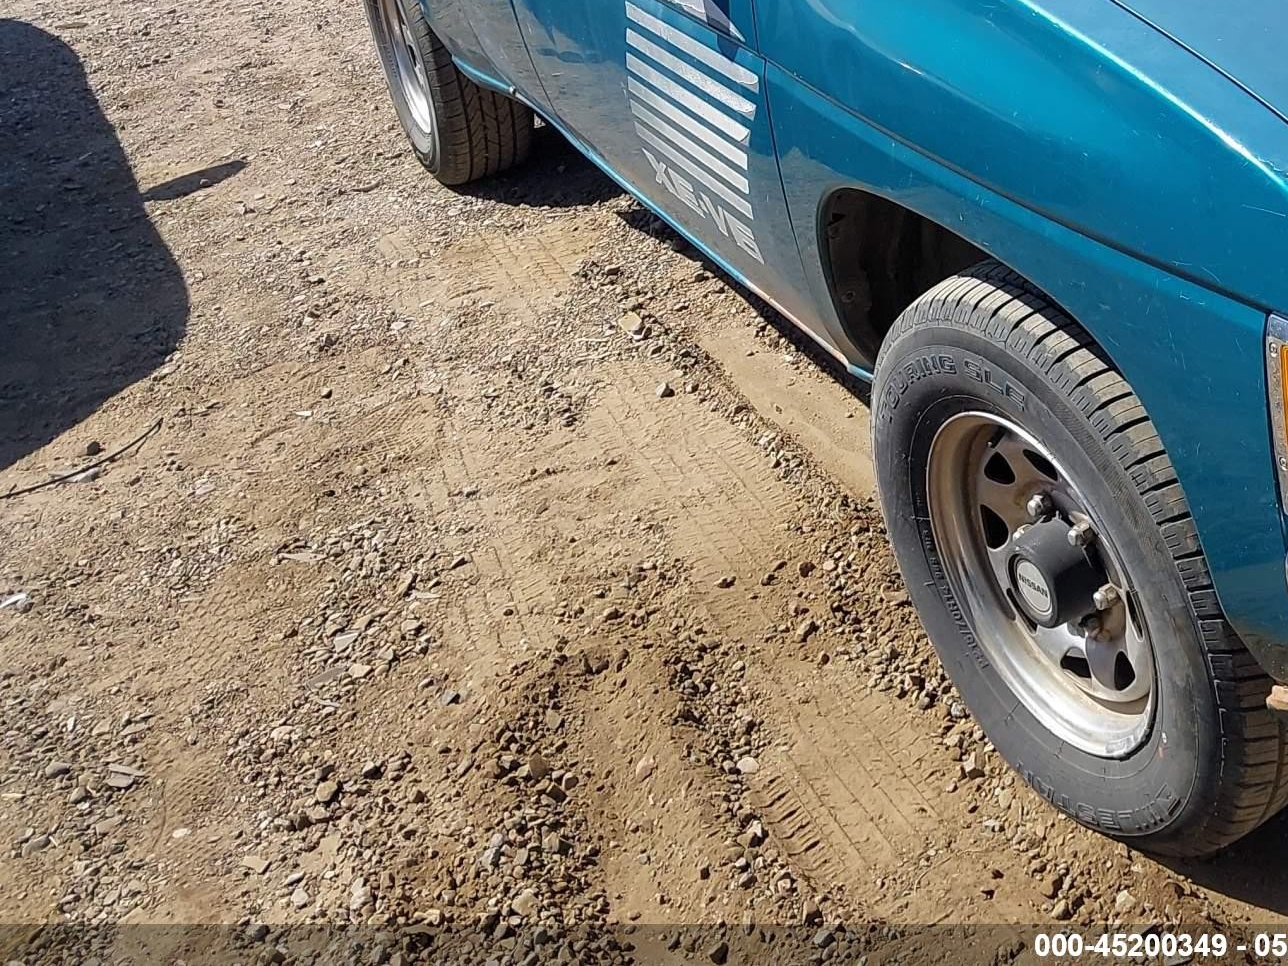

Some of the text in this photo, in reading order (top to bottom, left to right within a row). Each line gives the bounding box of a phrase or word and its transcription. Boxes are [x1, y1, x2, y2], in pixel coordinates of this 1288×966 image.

[879, 353, 1026, 424] TOURING SLE
[1018, 572, 1049, 599] NISSAN
